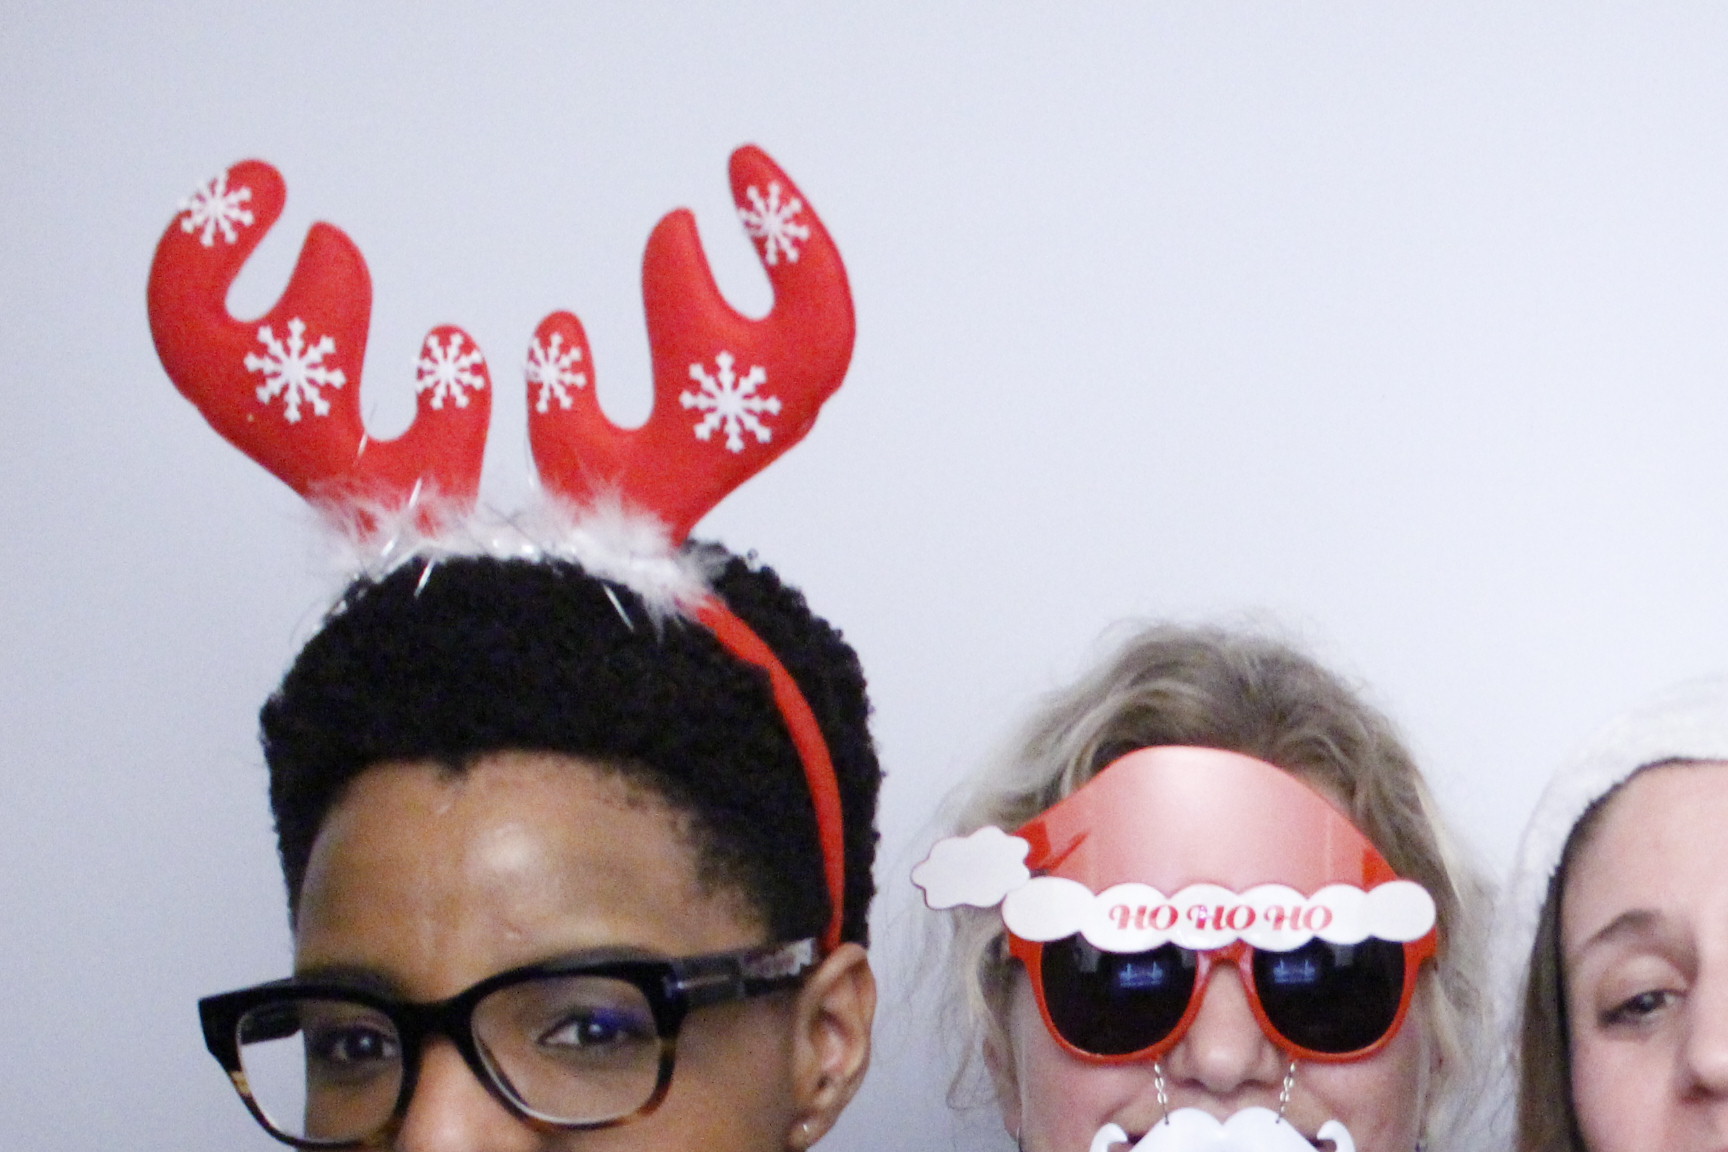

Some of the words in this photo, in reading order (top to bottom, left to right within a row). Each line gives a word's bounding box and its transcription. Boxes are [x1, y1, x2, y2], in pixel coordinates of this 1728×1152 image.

[1109, 904, 1179, 931] HO
[1186, 904, 1257, 931] HO
[1264, 904, 1333, 931] HO
